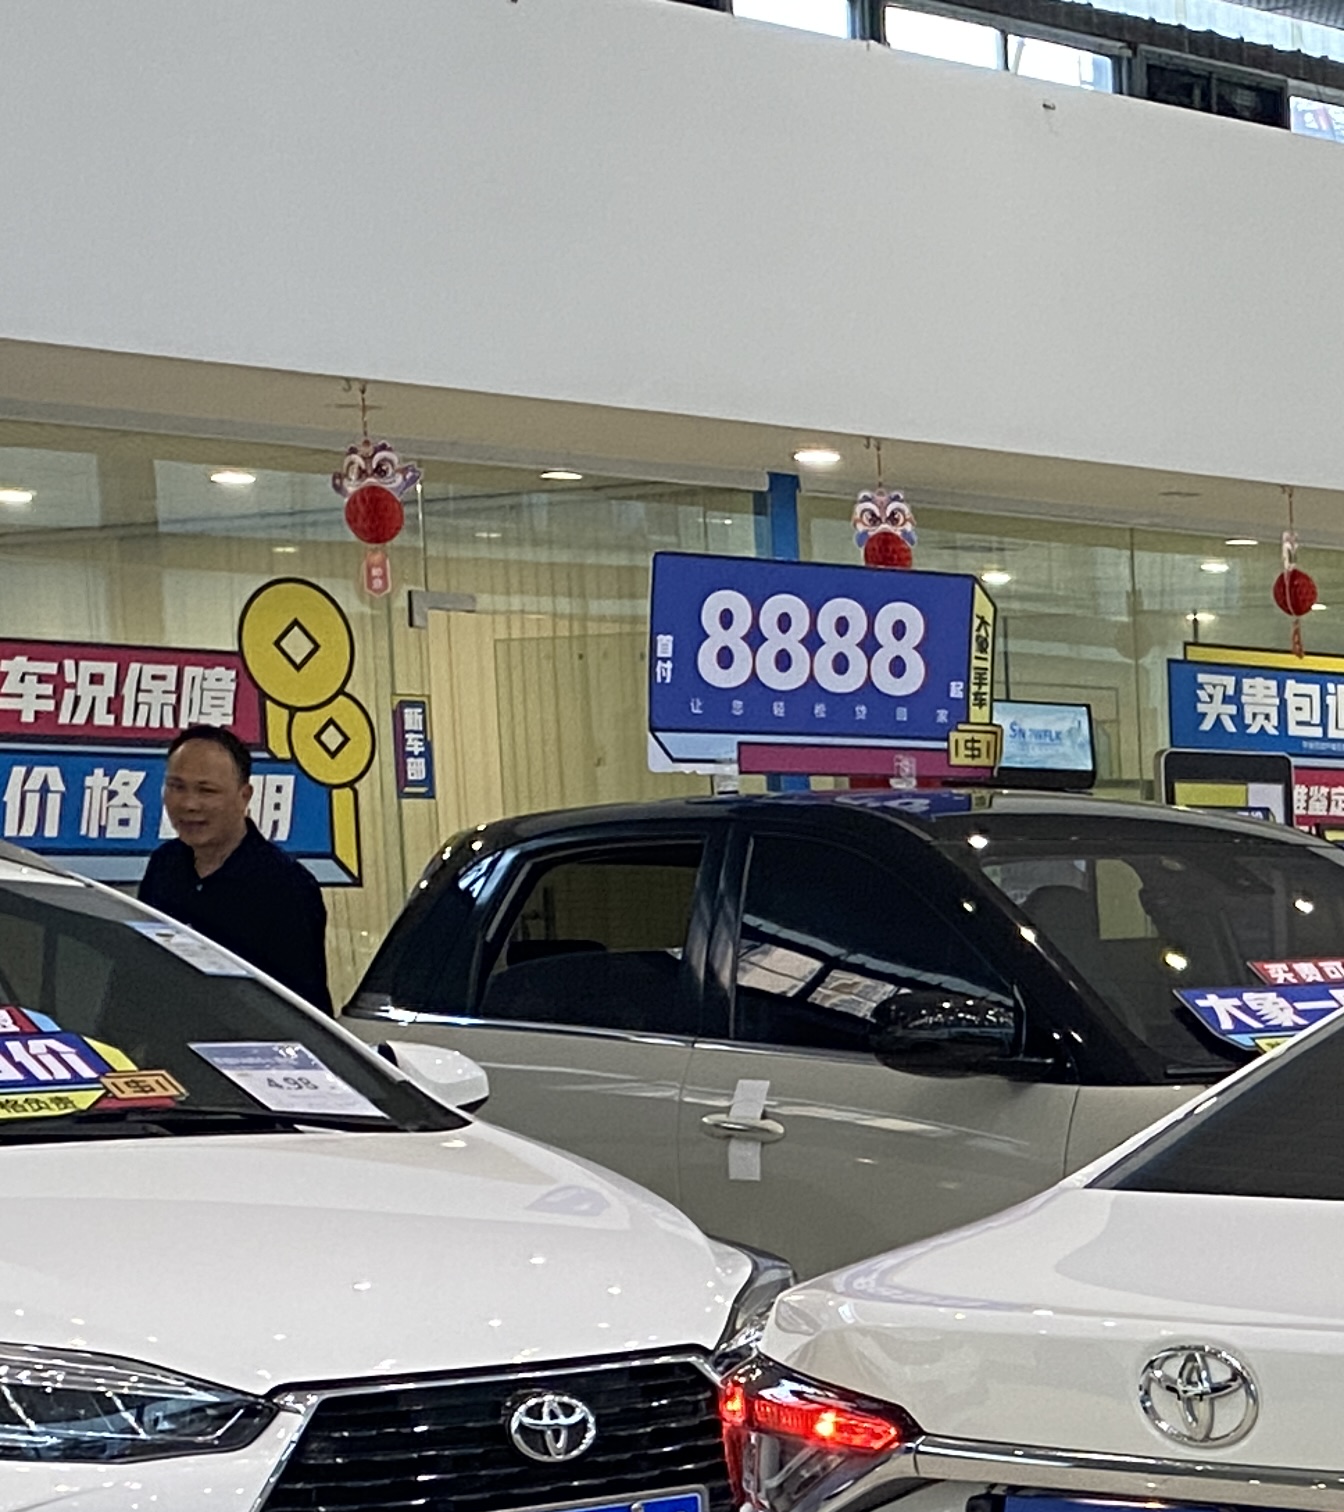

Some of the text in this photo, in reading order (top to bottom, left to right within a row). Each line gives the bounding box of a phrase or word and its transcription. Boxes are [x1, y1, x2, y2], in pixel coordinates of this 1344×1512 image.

[697, 589, 926, 697] 8888
[0, 655, 237, 728] 车况保障
[4, 764, 296, 842] 价格明
